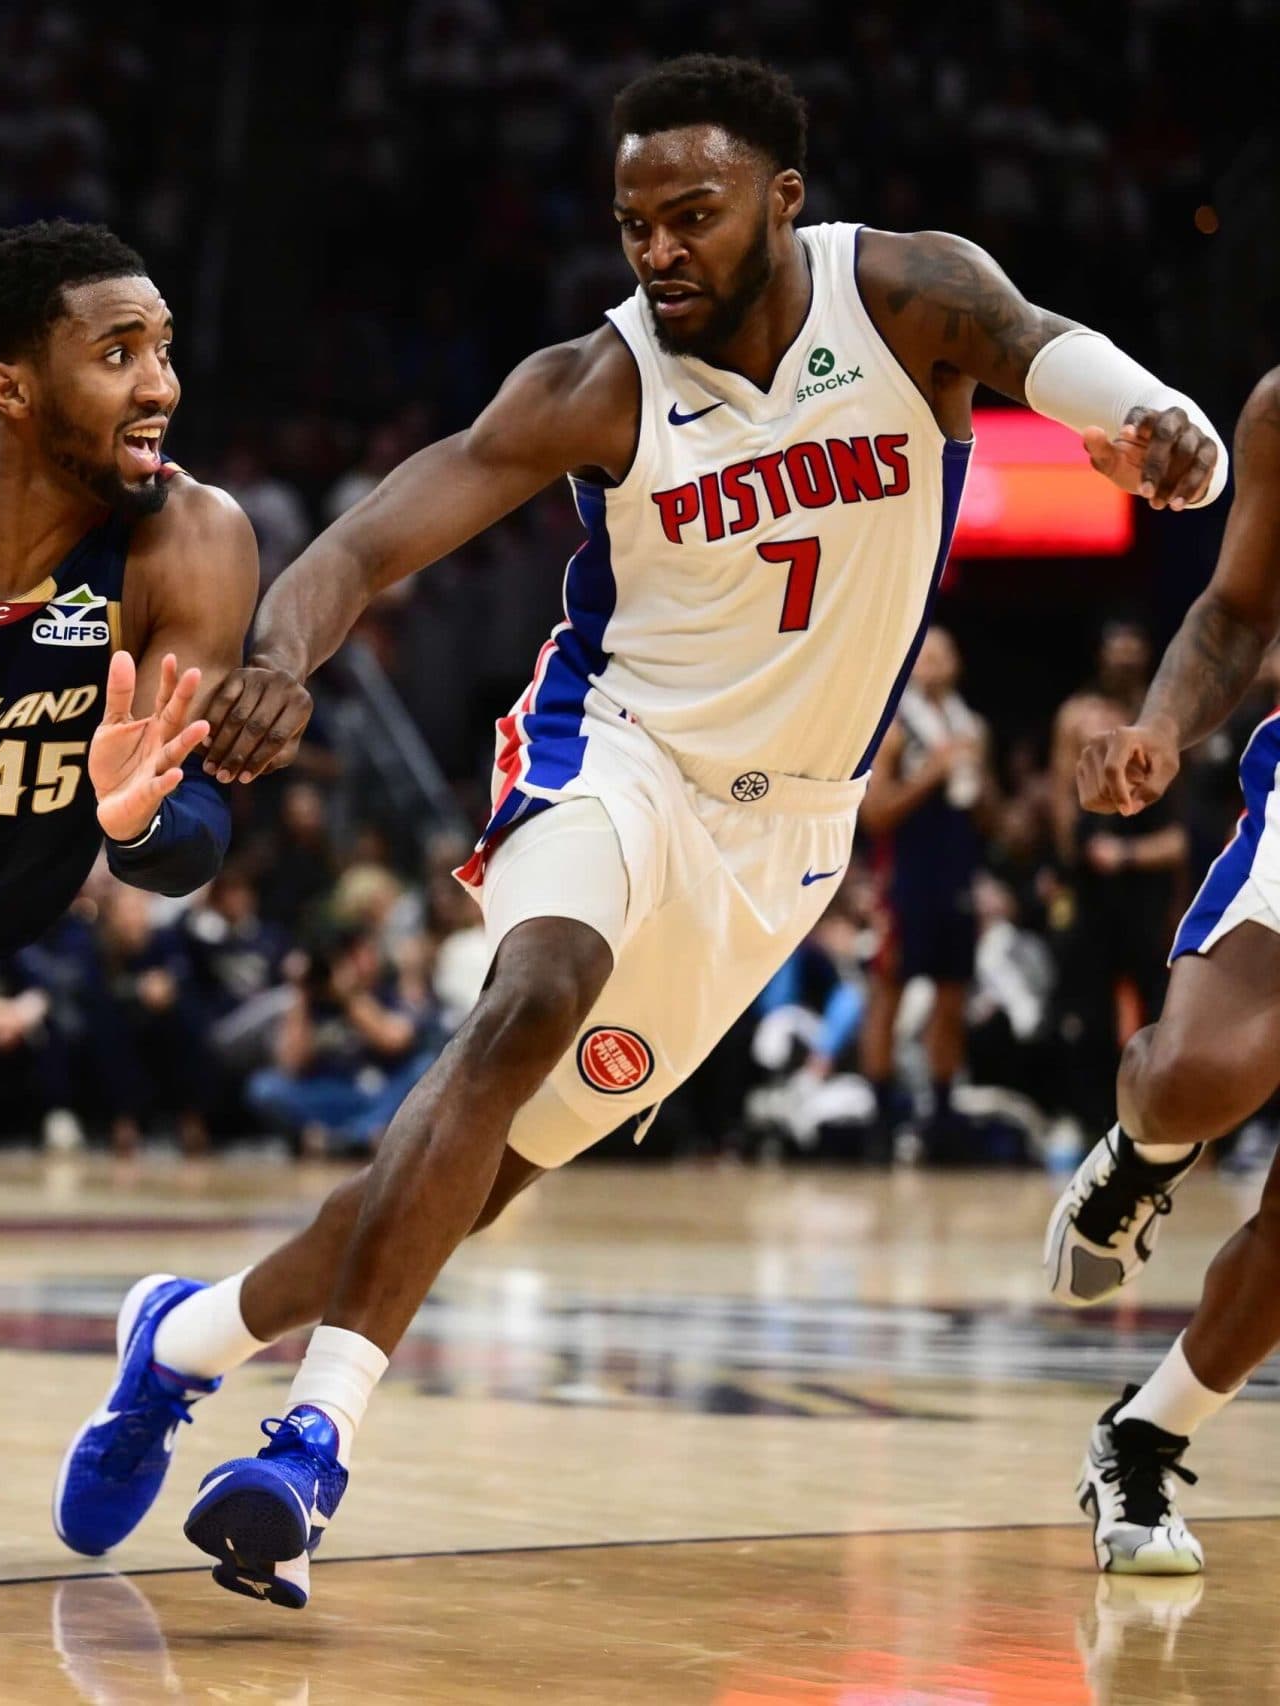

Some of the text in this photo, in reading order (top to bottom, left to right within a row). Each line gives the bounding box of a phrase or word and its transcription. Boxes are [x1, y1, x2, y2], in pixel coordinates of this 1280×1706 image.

[651, 433, 910, 545] PISTONS
[35, 624, 108, 641] CLIFFS
[756, 536, 821, 633] 7
